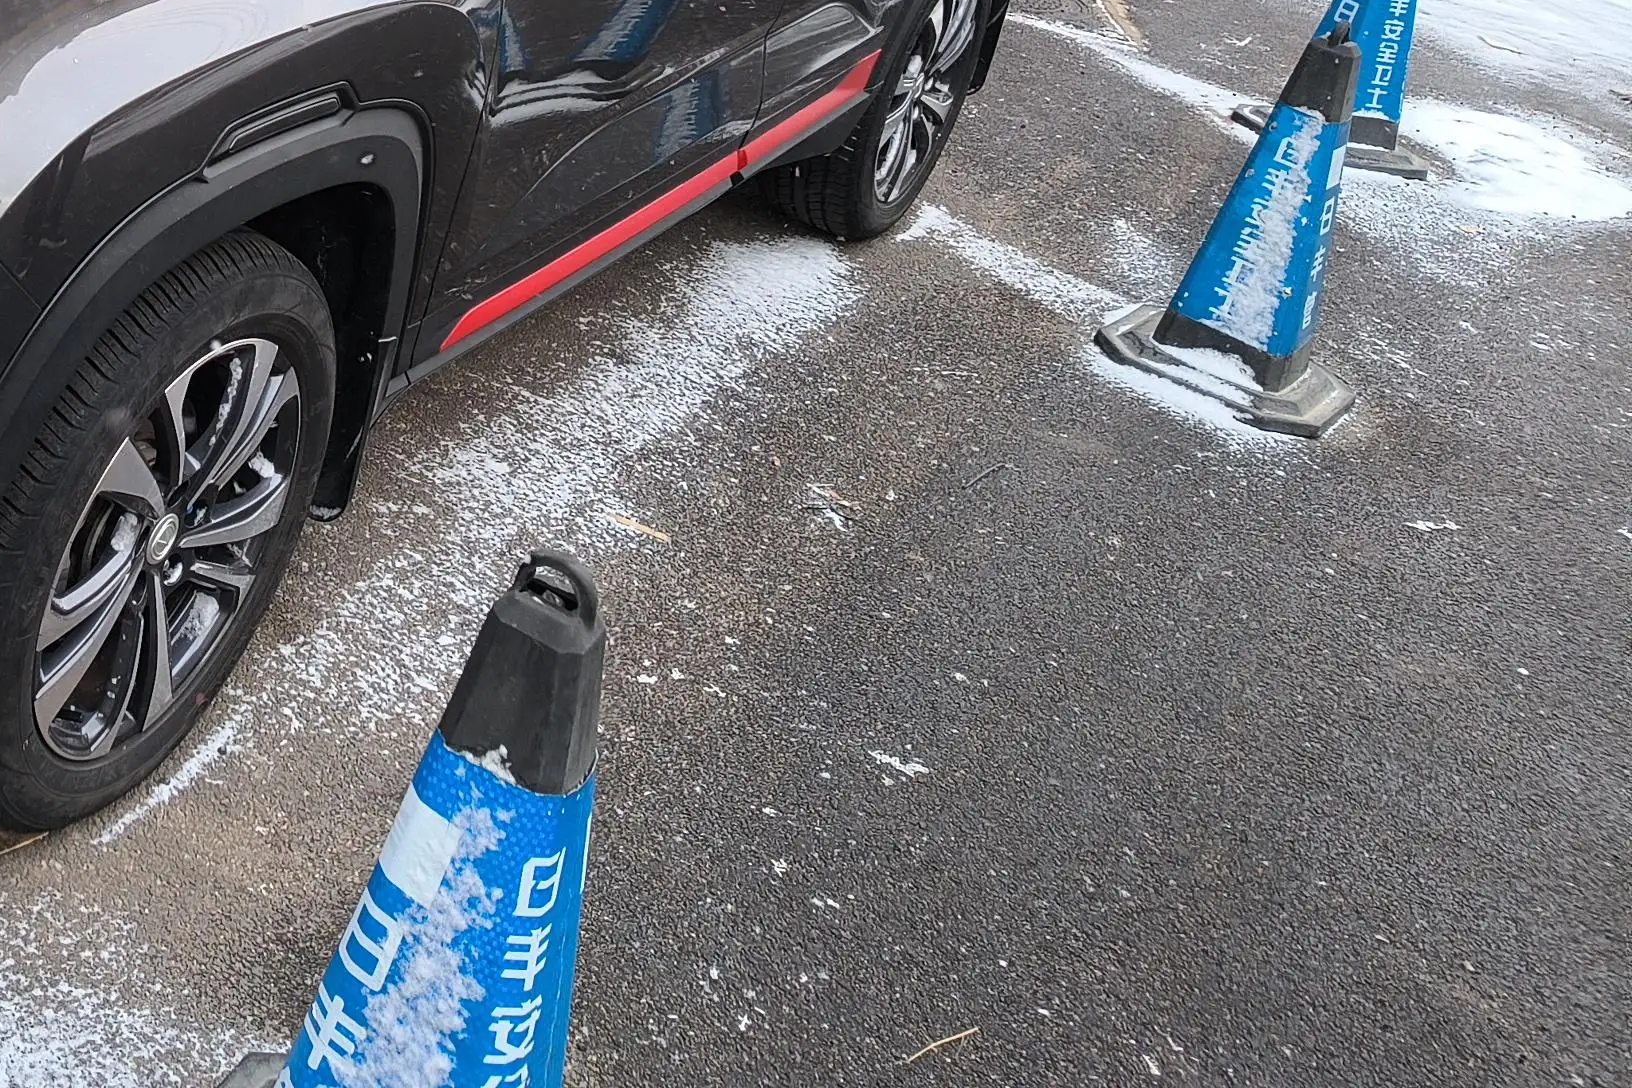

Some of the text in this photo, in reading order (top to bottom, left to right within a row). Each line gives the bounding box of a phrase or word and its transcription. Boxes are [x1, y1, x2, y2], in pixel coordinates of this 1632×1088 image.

[273, 884, 404, 1088] 日丰
[479, 847, 566, 1088] 日丰安
